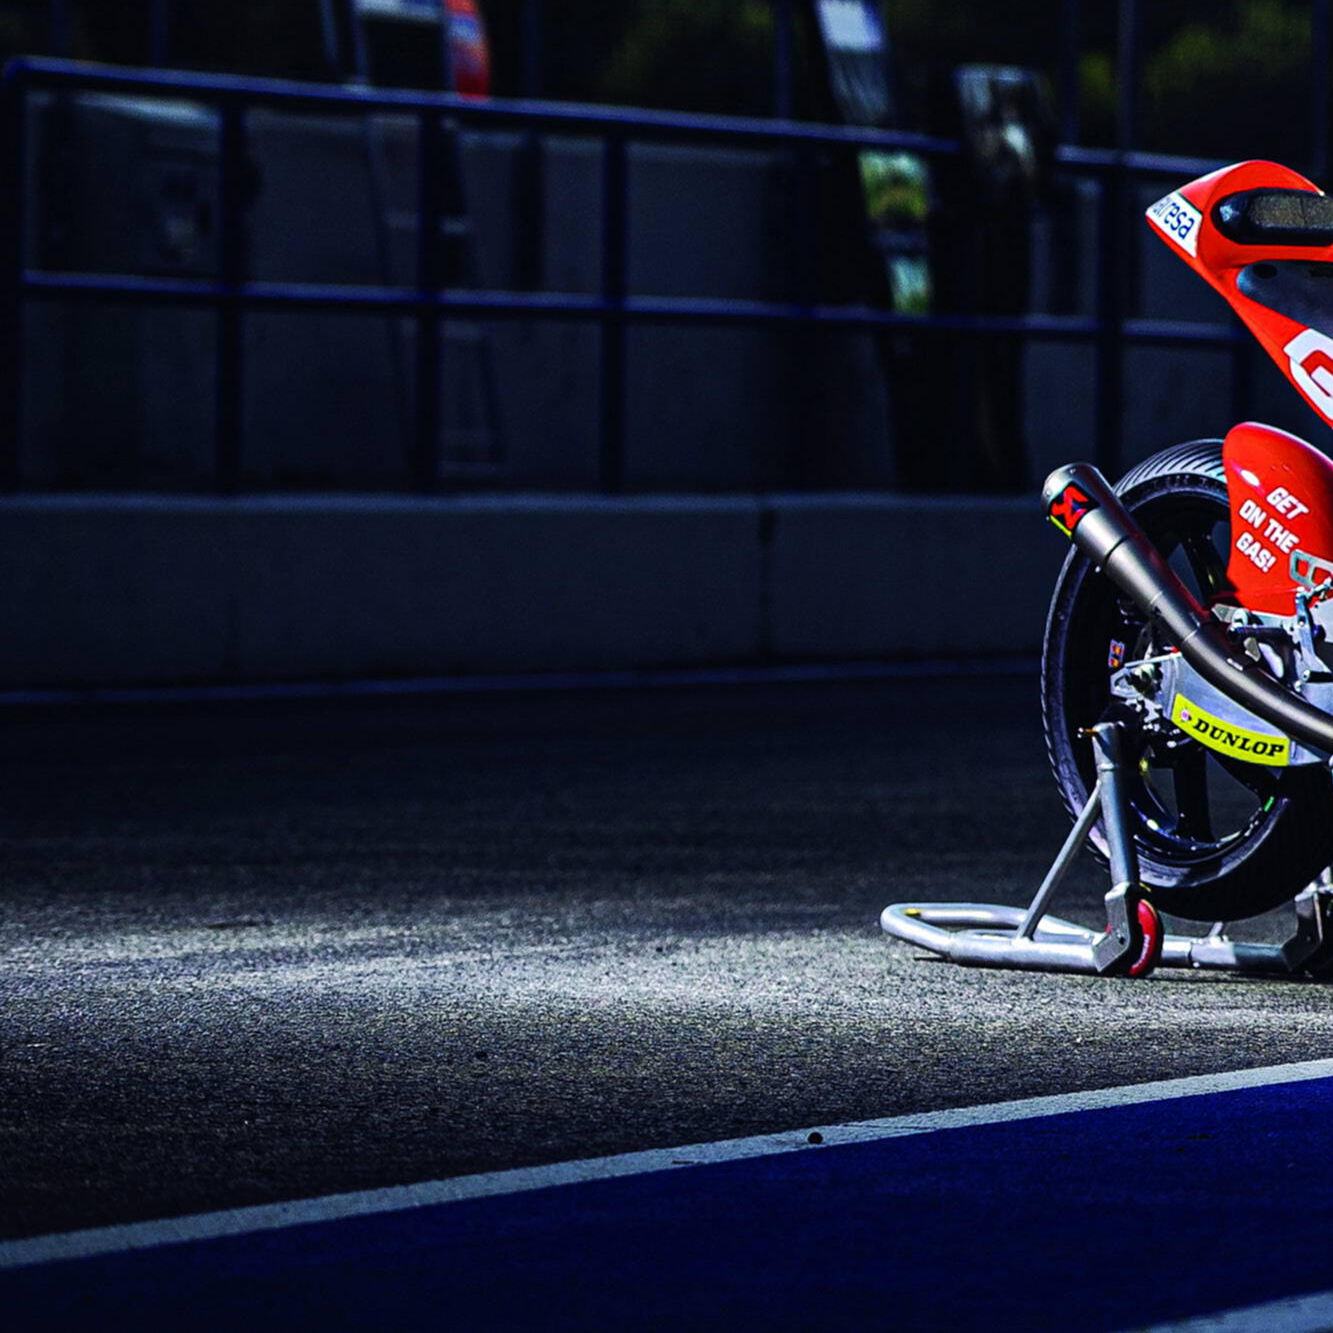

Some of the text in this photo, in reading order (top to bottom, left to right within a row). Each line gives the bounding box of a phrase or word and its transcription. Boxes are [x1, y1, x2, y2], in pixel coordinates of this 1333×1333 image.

[1266, 486, 1309, 520] GET
[1239, 499, 1300, 554] ON THE
[1236, 532, 1277, 573] GAS!
[1192, 717, 1285, 758] DUNLOP
